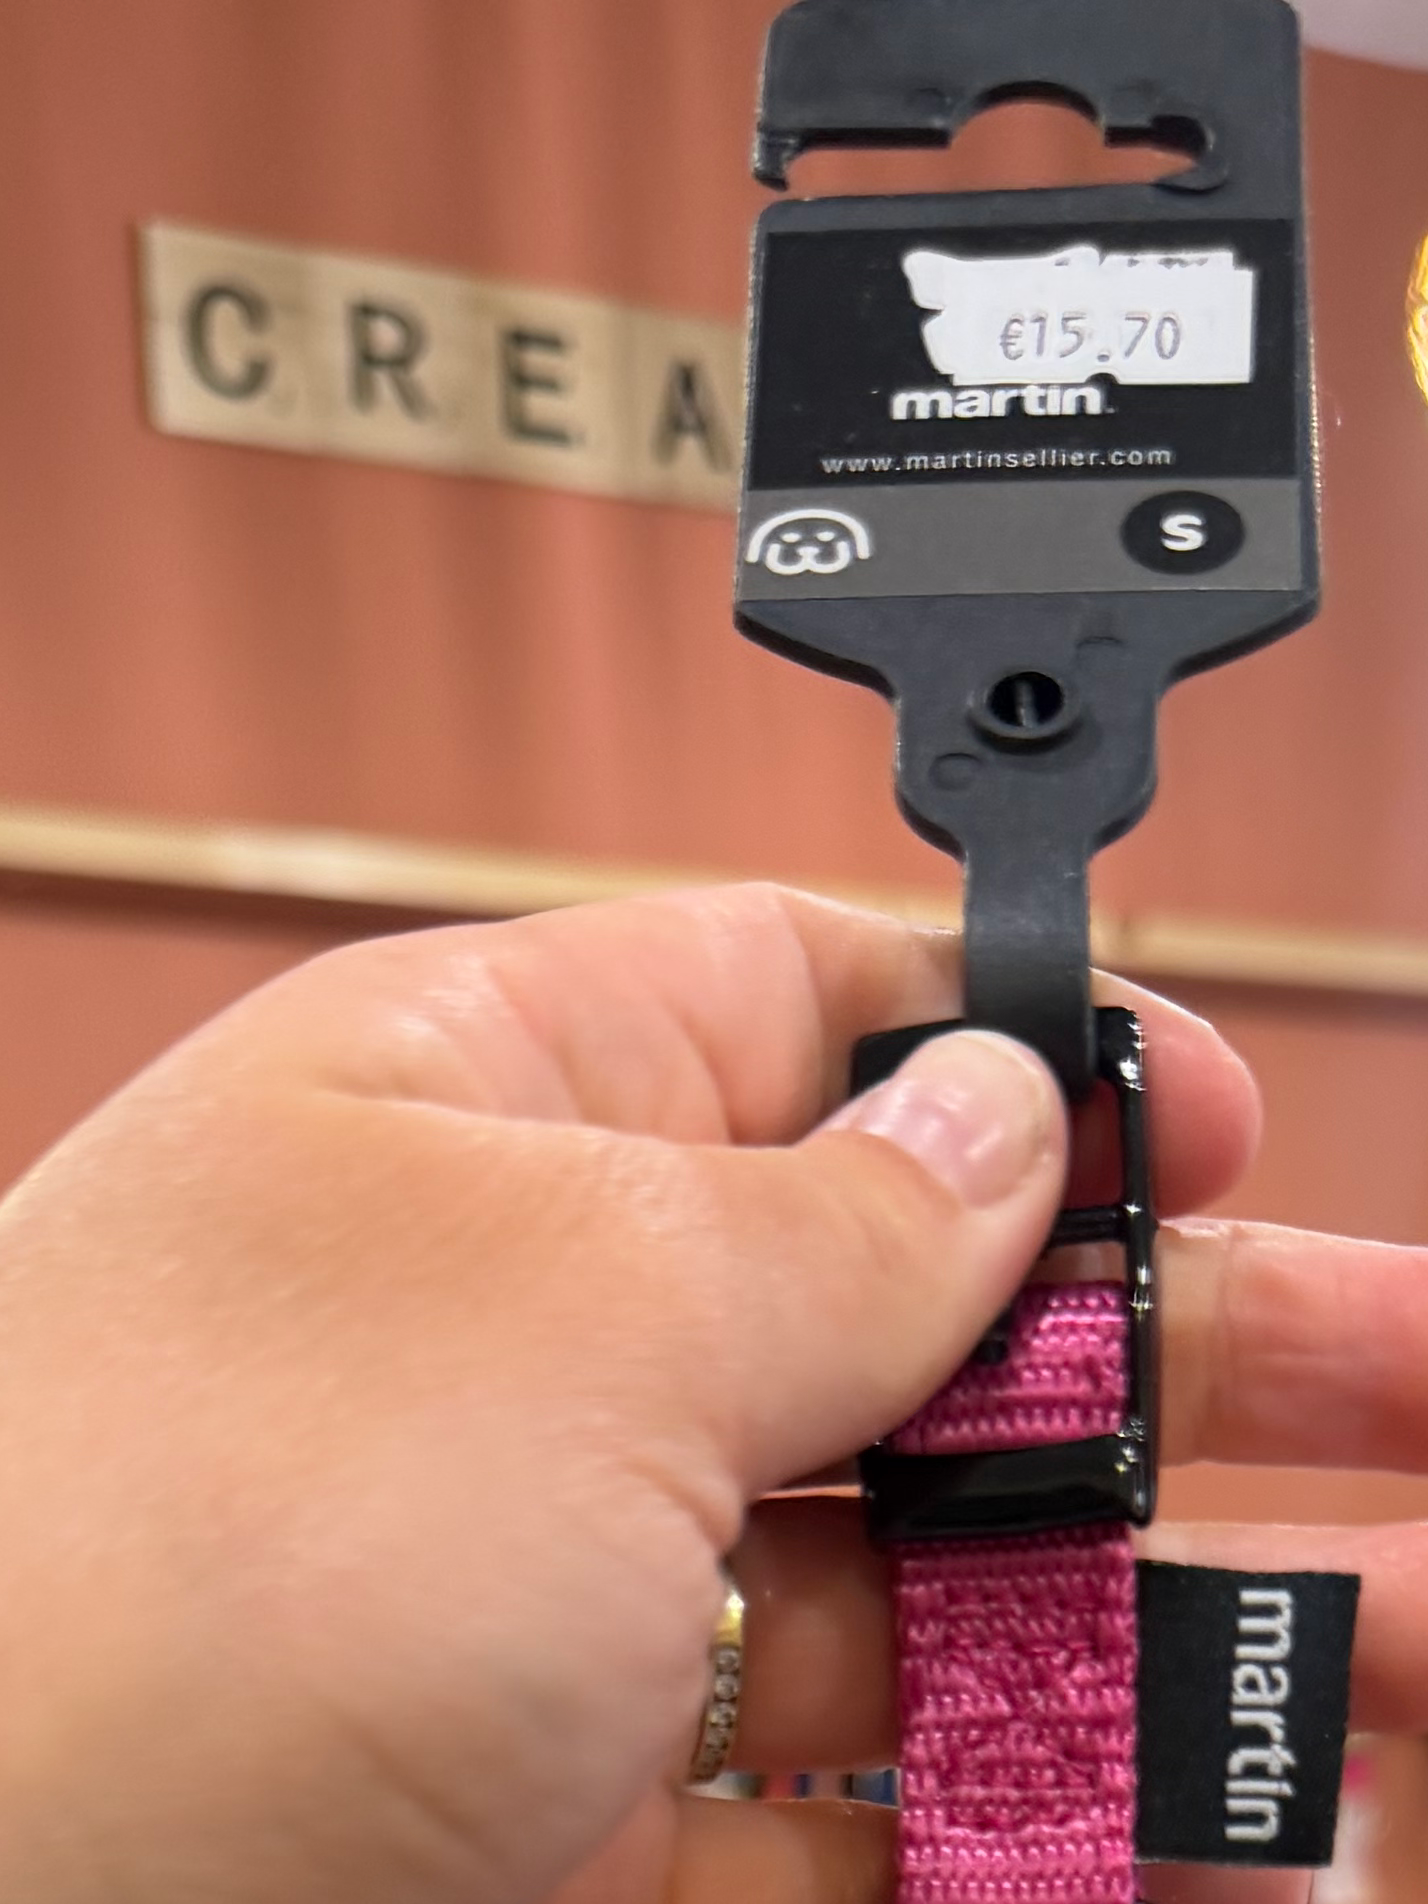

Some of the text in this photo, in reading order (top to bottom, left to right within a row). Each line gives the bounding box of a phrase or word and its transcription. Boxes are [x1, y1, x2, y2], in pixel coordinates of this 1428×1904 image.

[999, 310, 1181, 362] €15.70
[182, 280, 736, 474] CREA
[889, 384, 1108, 421] martin
[821, 448, 1174, 475] www.martinsellier.com
[1159, 513, 1208, 552] S
[1223, 1586, 1298, 1843] martin
